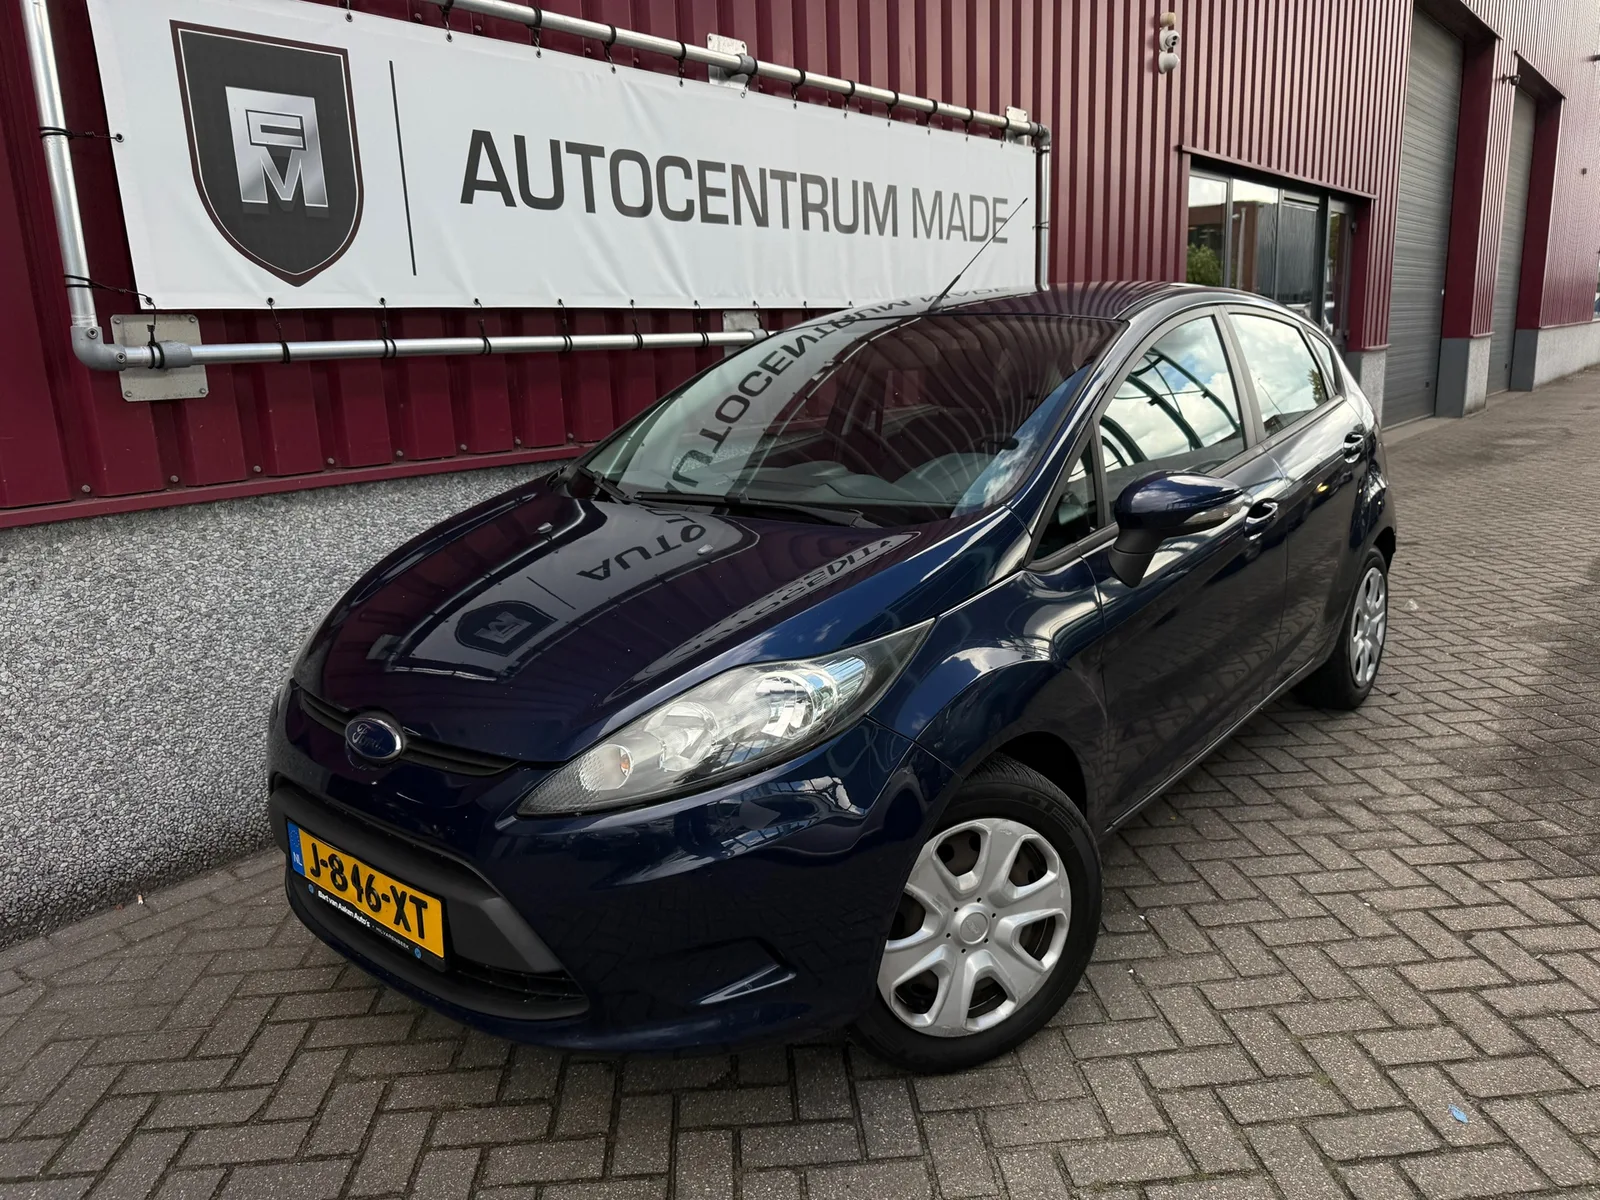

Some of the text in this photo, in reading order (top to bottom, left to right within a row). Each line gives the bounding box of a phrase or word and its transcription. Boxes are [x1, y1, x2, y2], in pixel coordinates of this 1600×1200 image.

[460, 129, 1008, 244] AUTOCENTRUM MADE
[292, 851, 303, 867] NL
[310, 842, 428, 940] J-846-XT
